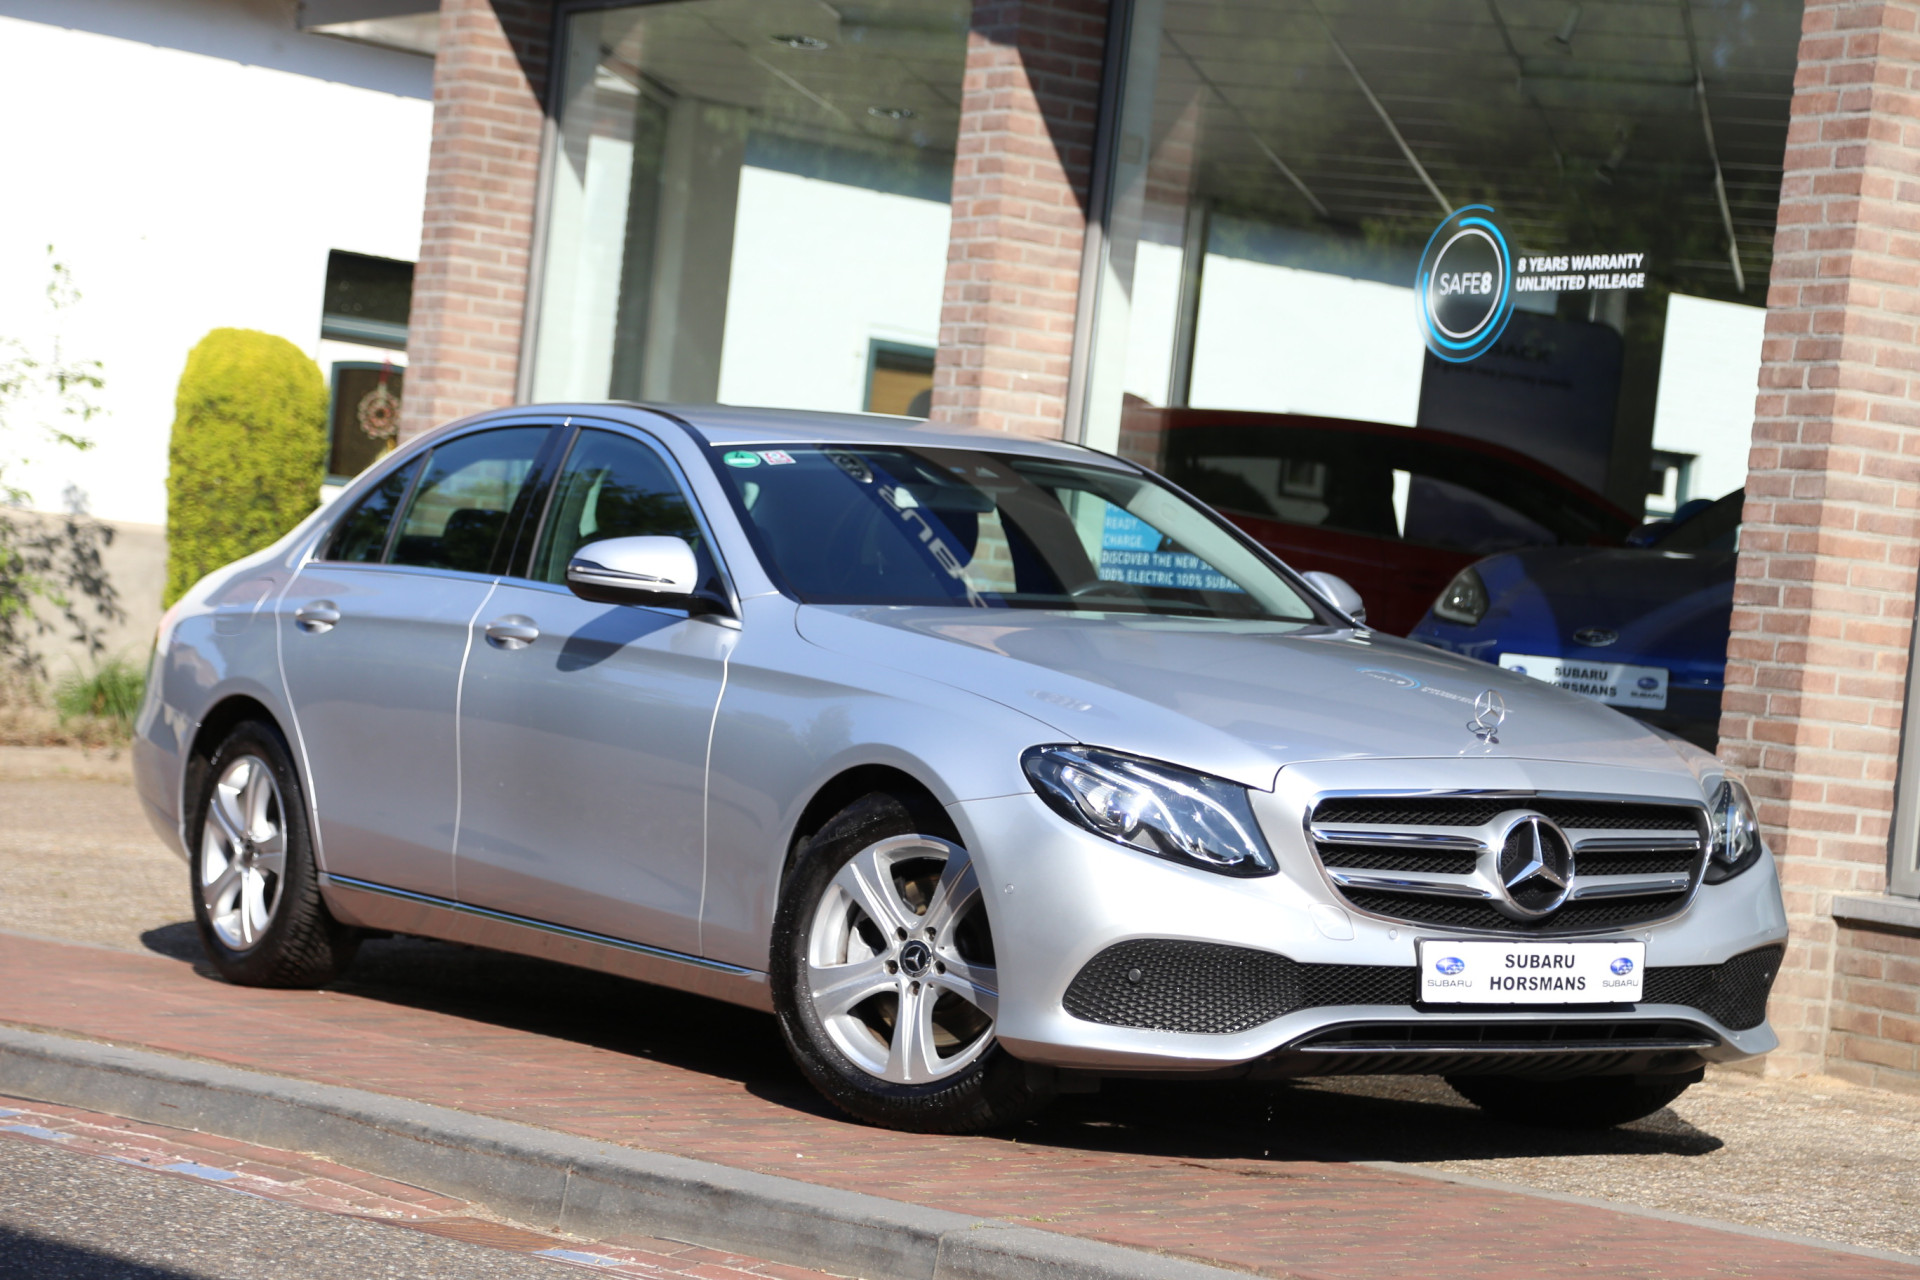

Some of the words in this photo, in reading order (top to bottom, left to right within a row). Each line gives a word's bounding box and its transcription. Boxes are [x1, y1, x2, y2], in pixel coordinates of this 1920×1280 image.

[1517, 257, 1527, 273] 8
[1529, 256, 1569, 272] YEARS
[1571, 253, 1645, 270] WARRANTY
[1439, 271, 1492, 295] SAFE8
[1516, 275, 1586, 292] UNLIMITED
[1588, 273, 1646, 290] MILEAGE
[1101, 550, 1150, 566] DISCOVER
[1152, 553, 1172, 568] THE
[1174, 554, 1199, 569] NEW
[1099, 567, 1125, 582] 100%
[1127, 569, 1174, 585] ELECTRIC
[1176, 573, 1202, 588] 100%
[1555, 666, 1609, 681] SUBARU
[1505, 954, 1576, 969] SUBARU
[1427, 979, 1473, 988] SUBARU
[1489, 976, 1587, 991] HORSMANS
[1602, 979, 1639, 988] SUBARU
